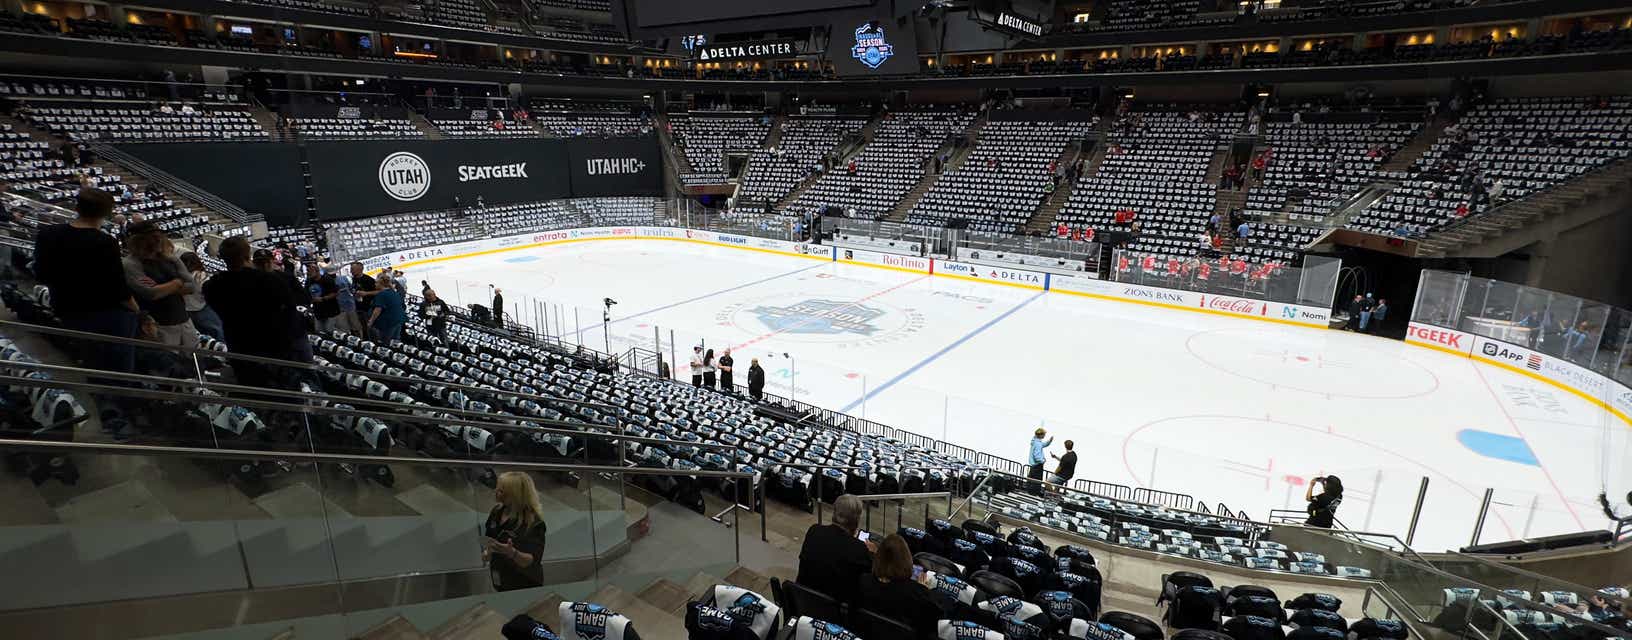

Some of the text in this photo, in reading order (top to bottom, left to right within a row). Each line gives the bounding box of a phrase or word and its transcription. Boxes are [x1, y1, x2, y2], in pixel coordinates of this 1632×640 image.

[1003, 14, 1042, 36] DELTA CENTER
[858, 39, 883, 48] SEASON
[710, 43, 791, 59] DELTA CENTER
[390, 158, 420, 168] HOCKEY
[587, 157, 646, 175] UTAH HC+
[387, 168, 424, 185] UTAH
[458, 162, 528, 182] SEATGEEK
[397, 188, 419, 197] CLUB
[533, 231, 568, 243] entrata
[409, 248, 444, 260] DELTA
[943, 262, 969, 273] Layton
[1001, 271, 1040, 284] DELTA
[1123, 287, 1185, 303] ZIONS BANK
[787, 303, 868, 324] SEASON
[1301, 310, 1327, 321] Nomi
[1499, 348, 1524, 362] App
[938, 580, 960, 594] GAME
[1050, 600, 1073, 611] GAME
[577, 611, 607, 627] GAME
[701, 606, 732, 621] GAME
[956, 625, 985, 638] GAME
